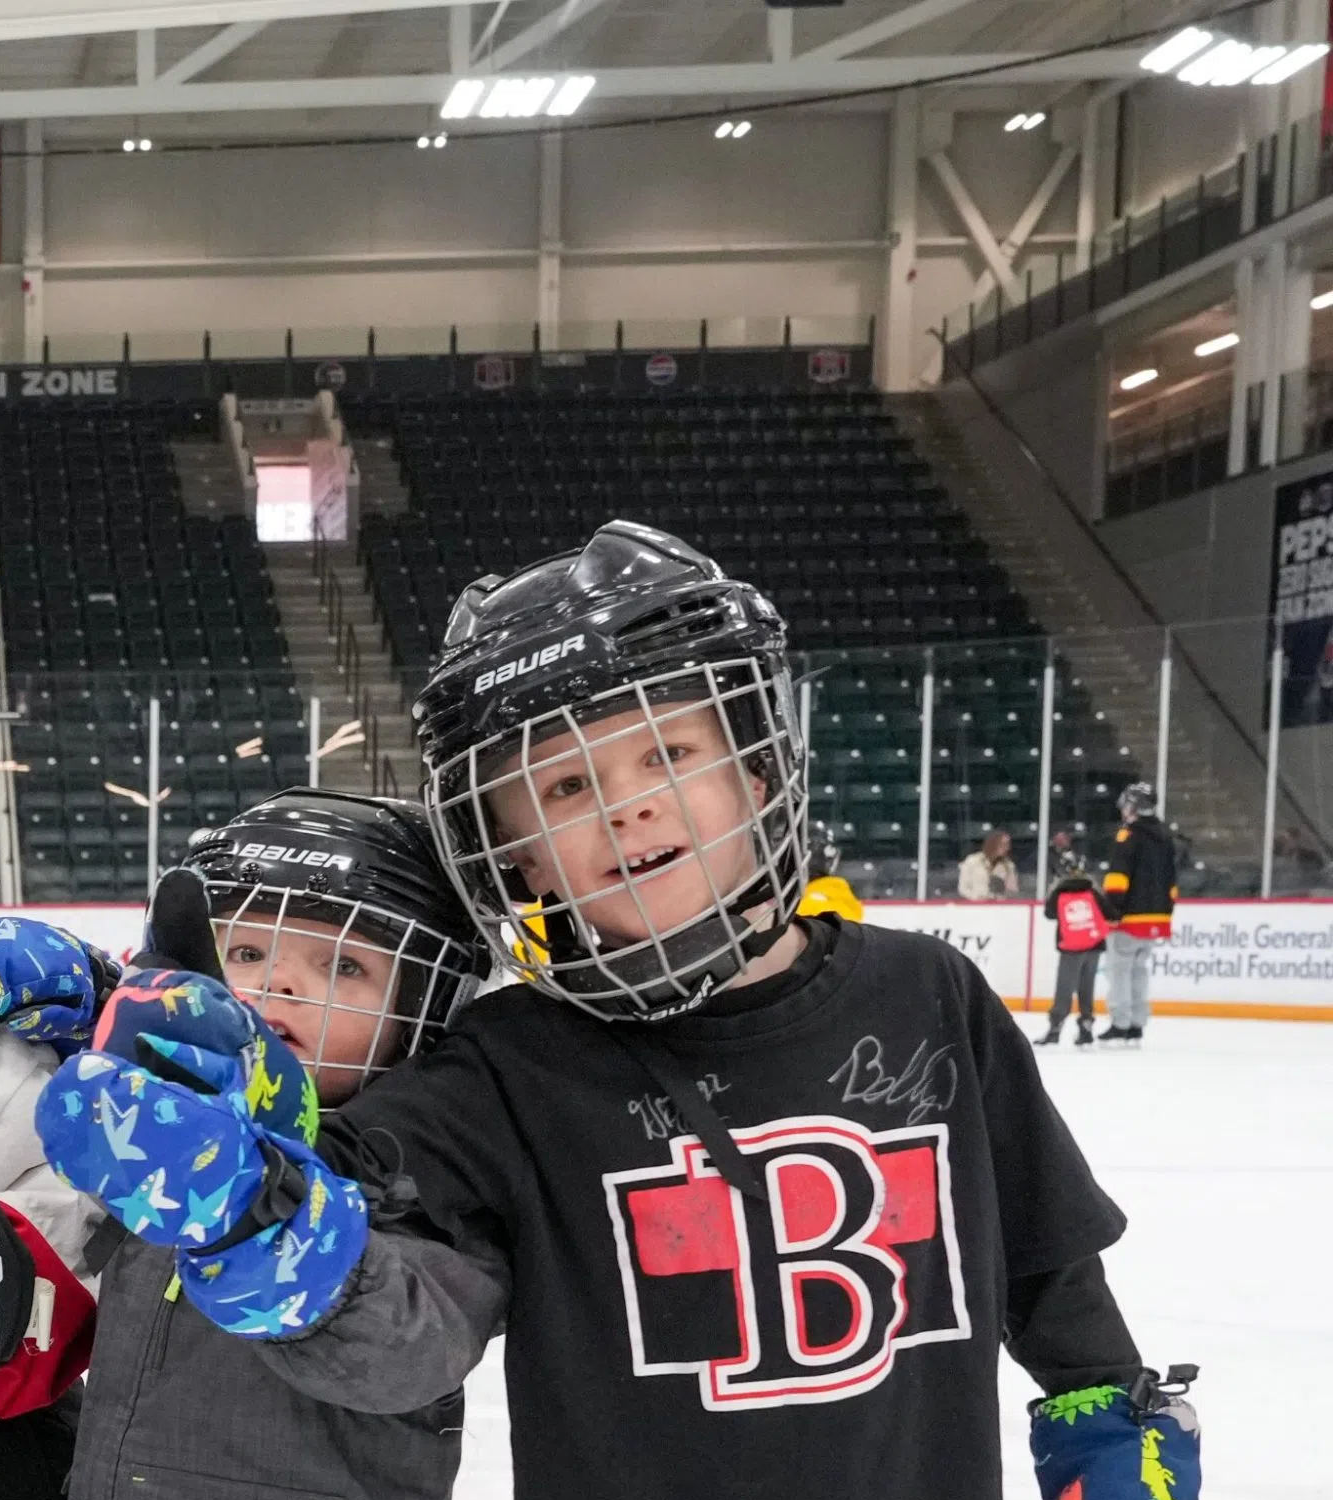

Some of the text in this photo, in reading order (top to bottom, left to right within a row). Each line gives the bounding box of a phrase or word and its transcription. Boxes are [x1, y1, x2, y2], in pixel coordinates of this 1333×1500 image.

[21, 369, 118, 396] ZONE
[959, 935, 992, 951] TV
[1153, 924, 1250, 949] elleville
[1152, 952, 1243, 984] Hospital
[699, 1115, 908, 1411] B
